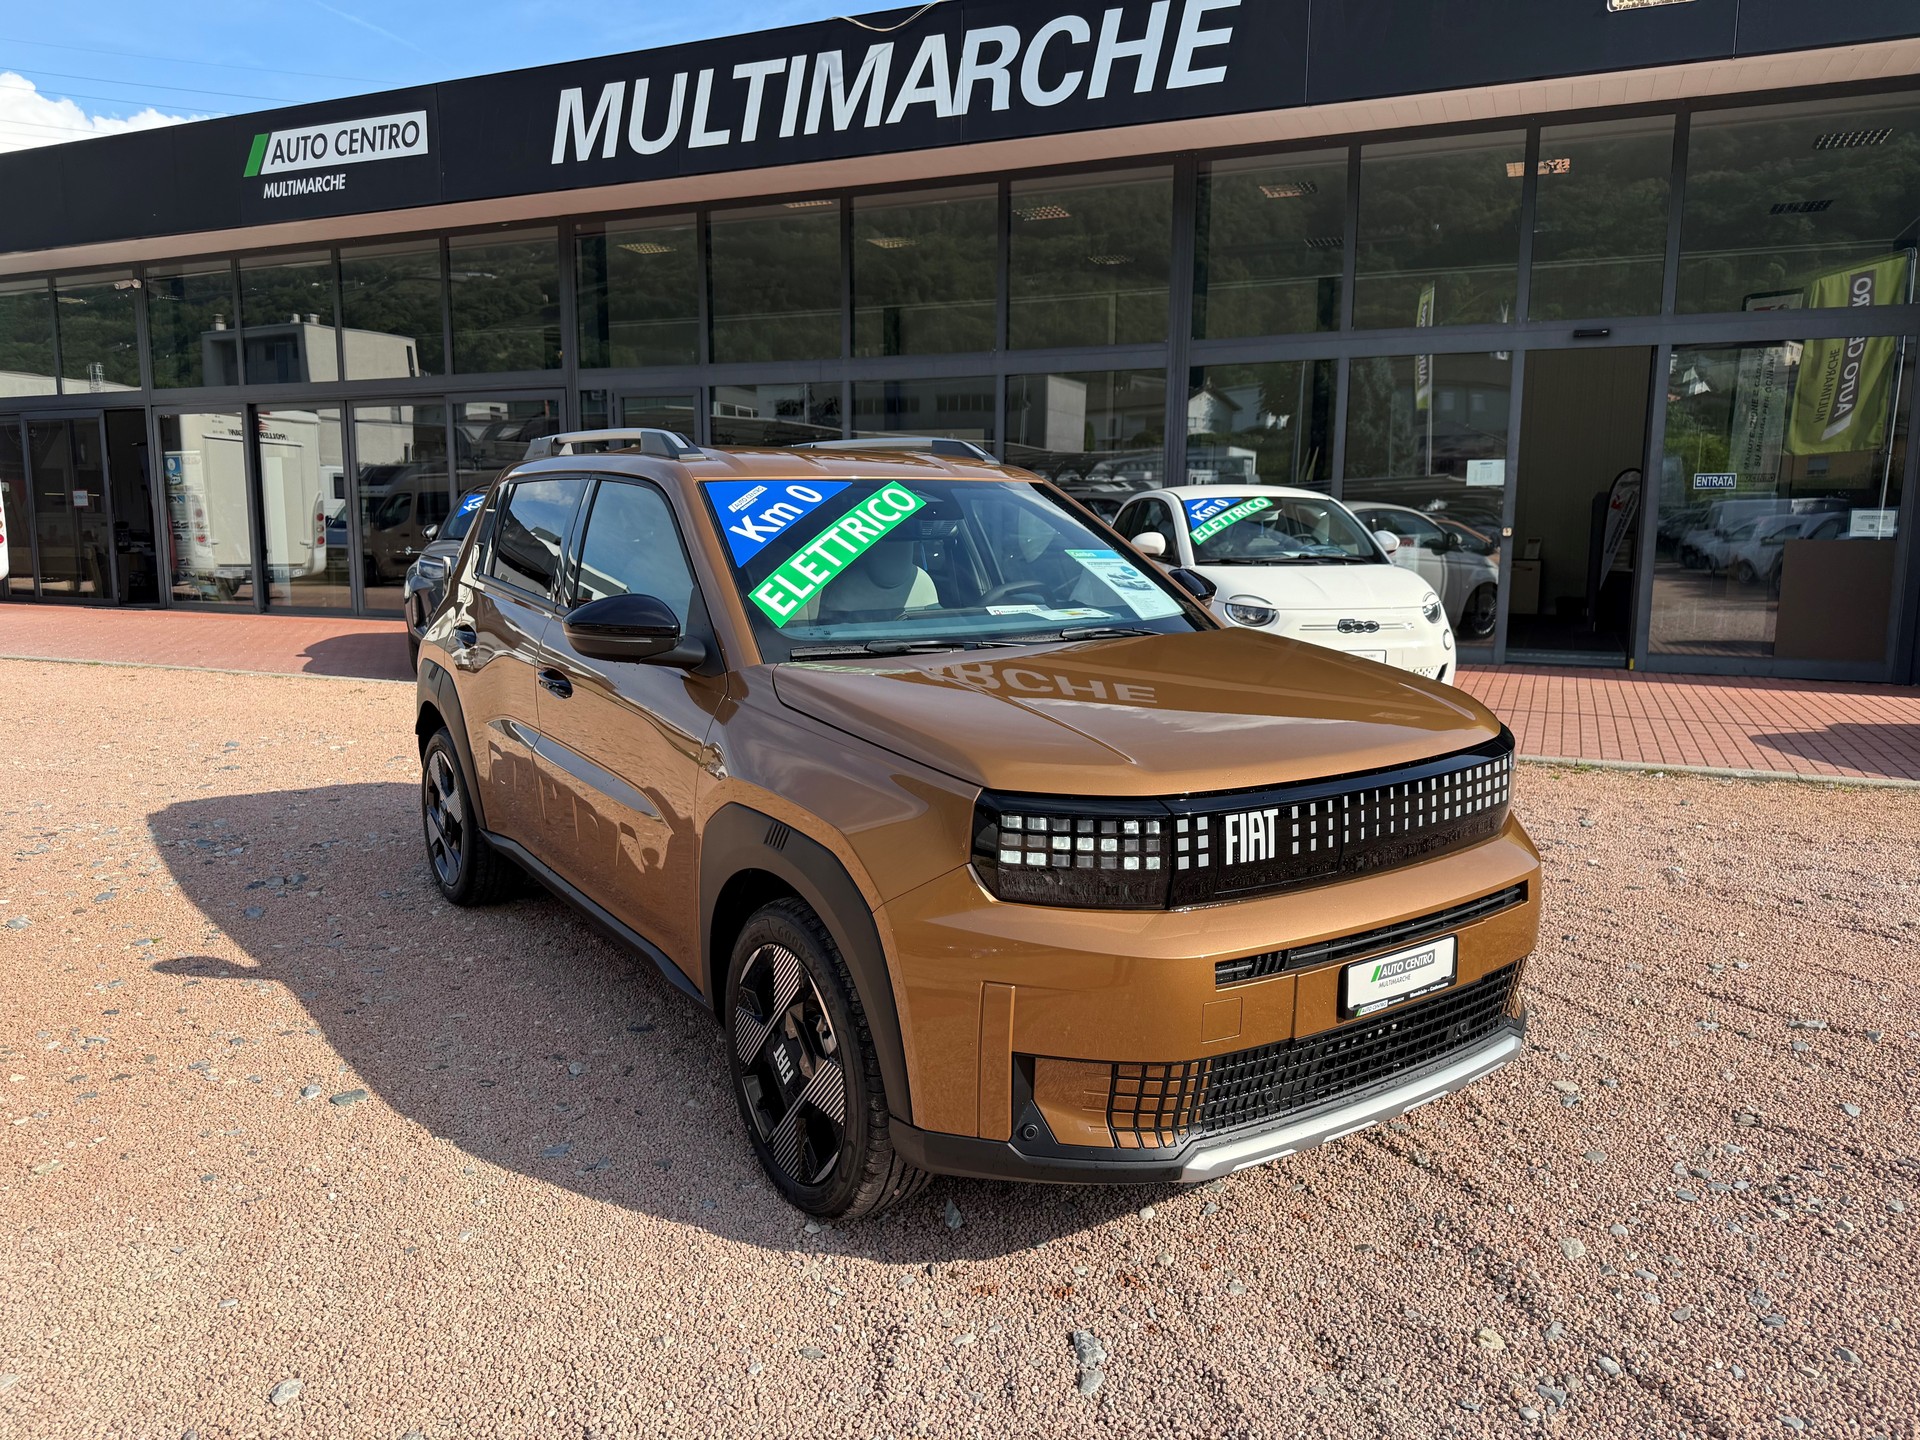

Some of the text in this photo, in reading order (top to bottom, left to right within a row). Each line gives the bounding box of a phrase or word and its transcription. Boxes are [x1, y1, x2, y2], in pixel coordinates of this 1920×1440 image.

[551, 0, 1242, 165] MULTIMARCHE
[270, 120, 420, 165] AUTO CENTRO
[263, 173, 347, 199] MULTIMARCHE
[1696, 475, 1734, 487] ENTRATA
[729, 502, 804, 543] Km
[785, 485, 823, 503] 0
[1190, 505, 1221, 521] Km
[1214, 499, 1230, 507] 0
[1193, 497, 1269, 539] ELETTRICO
[755, 488, 917, 617] ELETTRICO
[1337, 618, 1380, 633] 500
[1225, 808, 1279, 866] FIAT
[1378, 973, 1411, 988] MULTIMARCHE
[1381, 952, 1434, 978] AUTO CENTRO
[773, 1043, 795, 1086] FIAT
